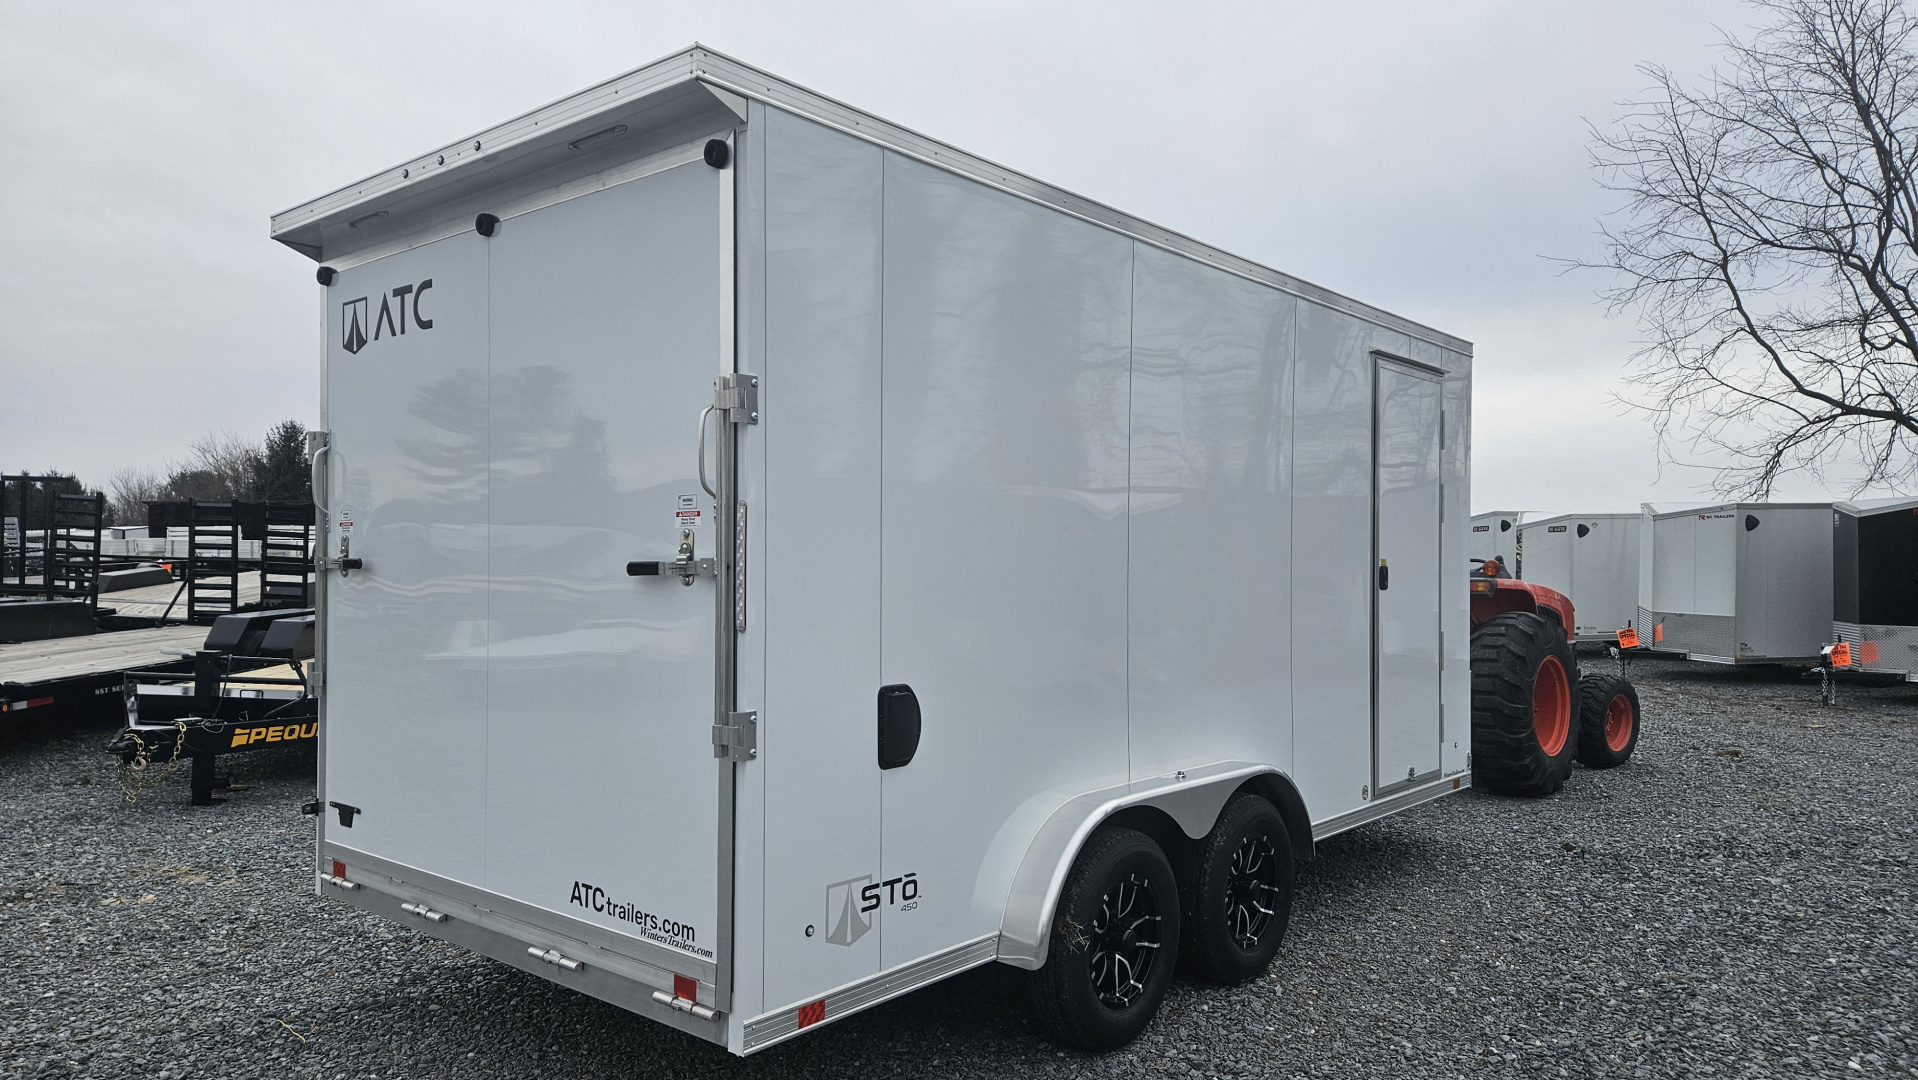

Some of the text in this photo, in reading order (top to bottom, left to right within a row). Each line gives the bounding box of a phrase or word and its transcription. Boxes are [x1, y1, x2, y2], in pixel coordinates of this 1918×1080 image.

[374, 278, 433, 341] ATC
[1619, 632, 1636, 640] SPECIAL
[248, 722, 318, 745] PEQU
[901, 901, 918, 912] 450
[640, 926, 714, 958] WintersTrailers.com
